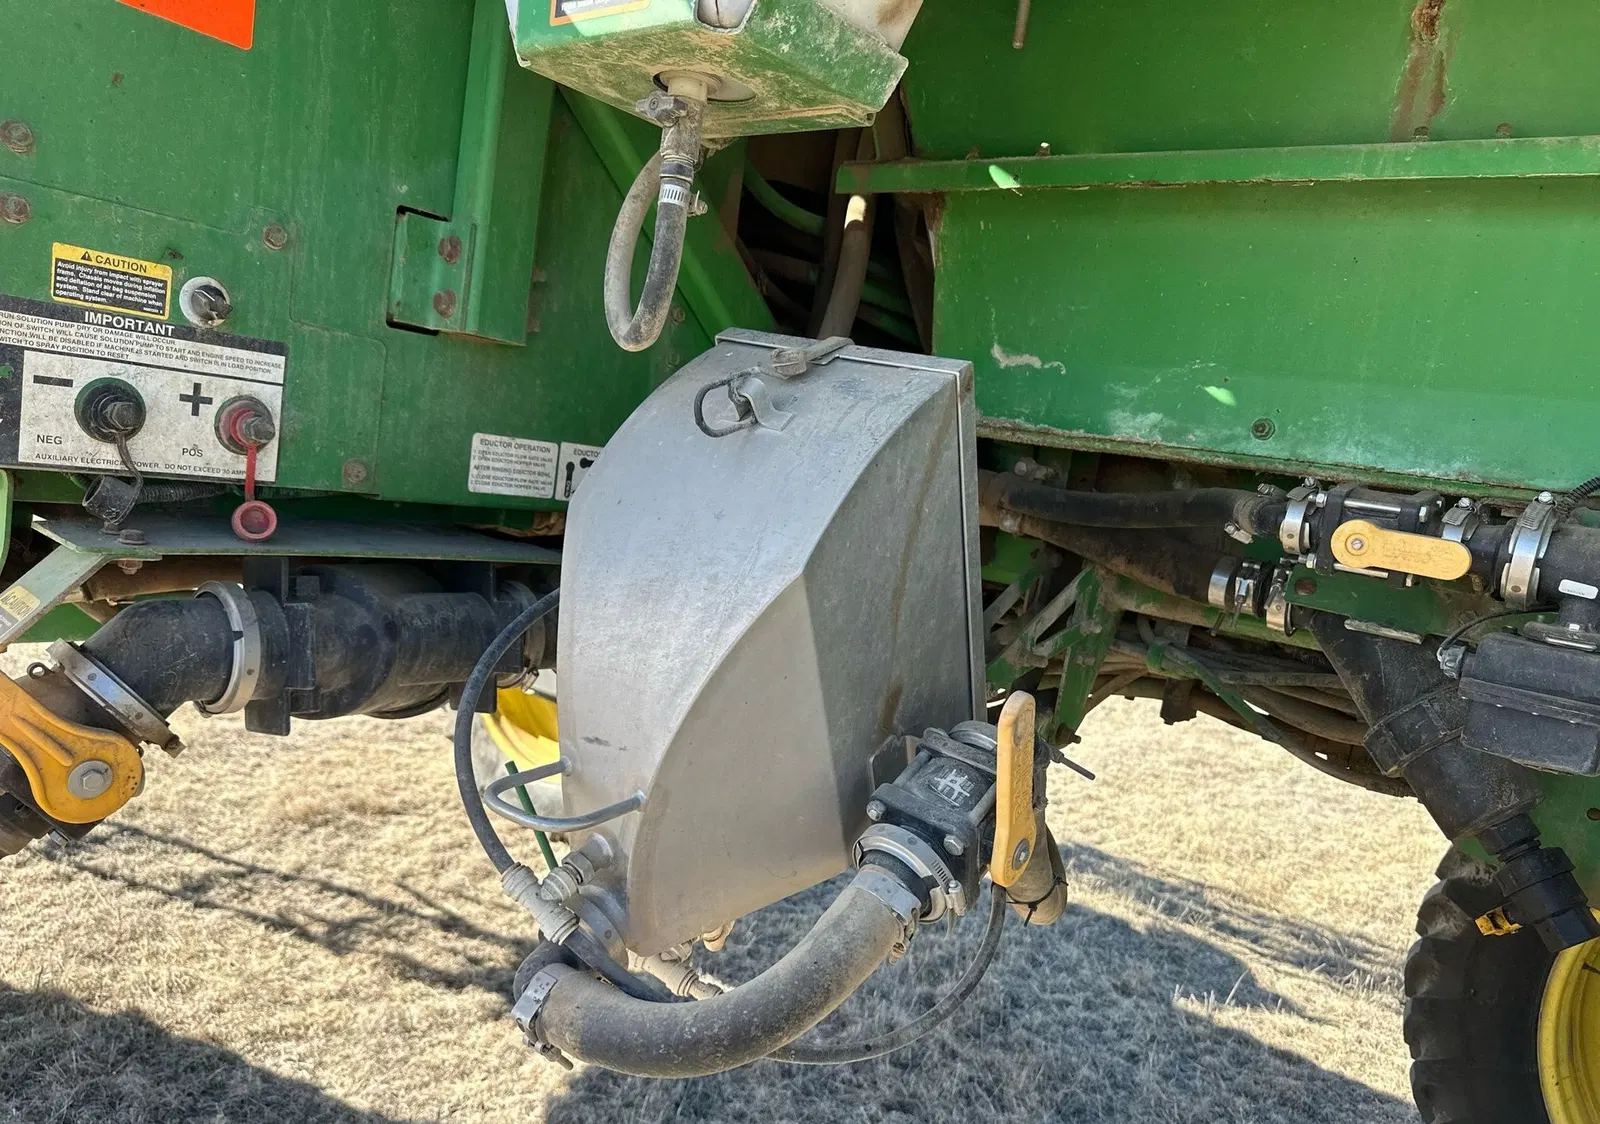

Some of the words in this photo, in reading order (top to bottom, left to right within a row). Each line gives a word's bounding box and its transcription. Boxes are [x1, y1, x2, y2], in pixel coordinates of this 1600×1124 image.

[96, 255, 146, 273] CAUTION
[76, 265, 94, 274] injury
[94, 268, 108, 276] from
[109, 271, 128, 281] impact
[130, 275, 142, 283] with
[142, 279, 164, 288] sprayer
[78, 272, 102, 282] Chassis
[104, 278, 122, 286] moves
[124, 280, 142, 290] during
[143, 284, 166, 294] inflation
[56, 282, 79, 292] system.
[82, 286, 100, 295] Stand
[100, 290, 116, 298] clear
[124, 294, 147, 304] machine
[148, 299, 162, 307] when
[56, 290, 84, 300] operating
[84, 296, 108, 304] system.
[69, 278, 95, 288] deflation
[124, 288, 156, 299] suspension
[16, 315, 52, 326] SOLUTION
[104, 328, 133, 338] DAMAGE
[85, 311, 175, 336] IMPORTANT
[26, 324, 54, 334] SWITCH
[56, 328, 72, 336] WILL
[75, 332, 98, 340] CAUSE
[100, 335, 134, 346] SOLUTION
[136, 340, 154, 348] PUMP
[166, 346, 186, 354] START
[202, 351, 224, 360] ENGINE
[225, 354, 244, 363] SPEED
[30, 332, 48, 341] WILL
[60, 338, 95, 348] DISABLED
[104, 343, 135, 352] MACHINE
[144, 350, 174, 360] STARTED
[190, 357, 212, 366] SWITCH
[36, 341, 60, 350] SPRAY
[62, 345, 94, 355] POSITION
[37, 434, 62, 444] NEG
[480, 438, 512, 448] EDUCTOR
[514, 442, 552, 454] OPERATION
[35, 453, 78, 462] AUXILIARY
[81, 457, 124, 466] ELECTRICA
[194, 466, 220, 474] EXCEED
[182, 448, 203, 458] POS
